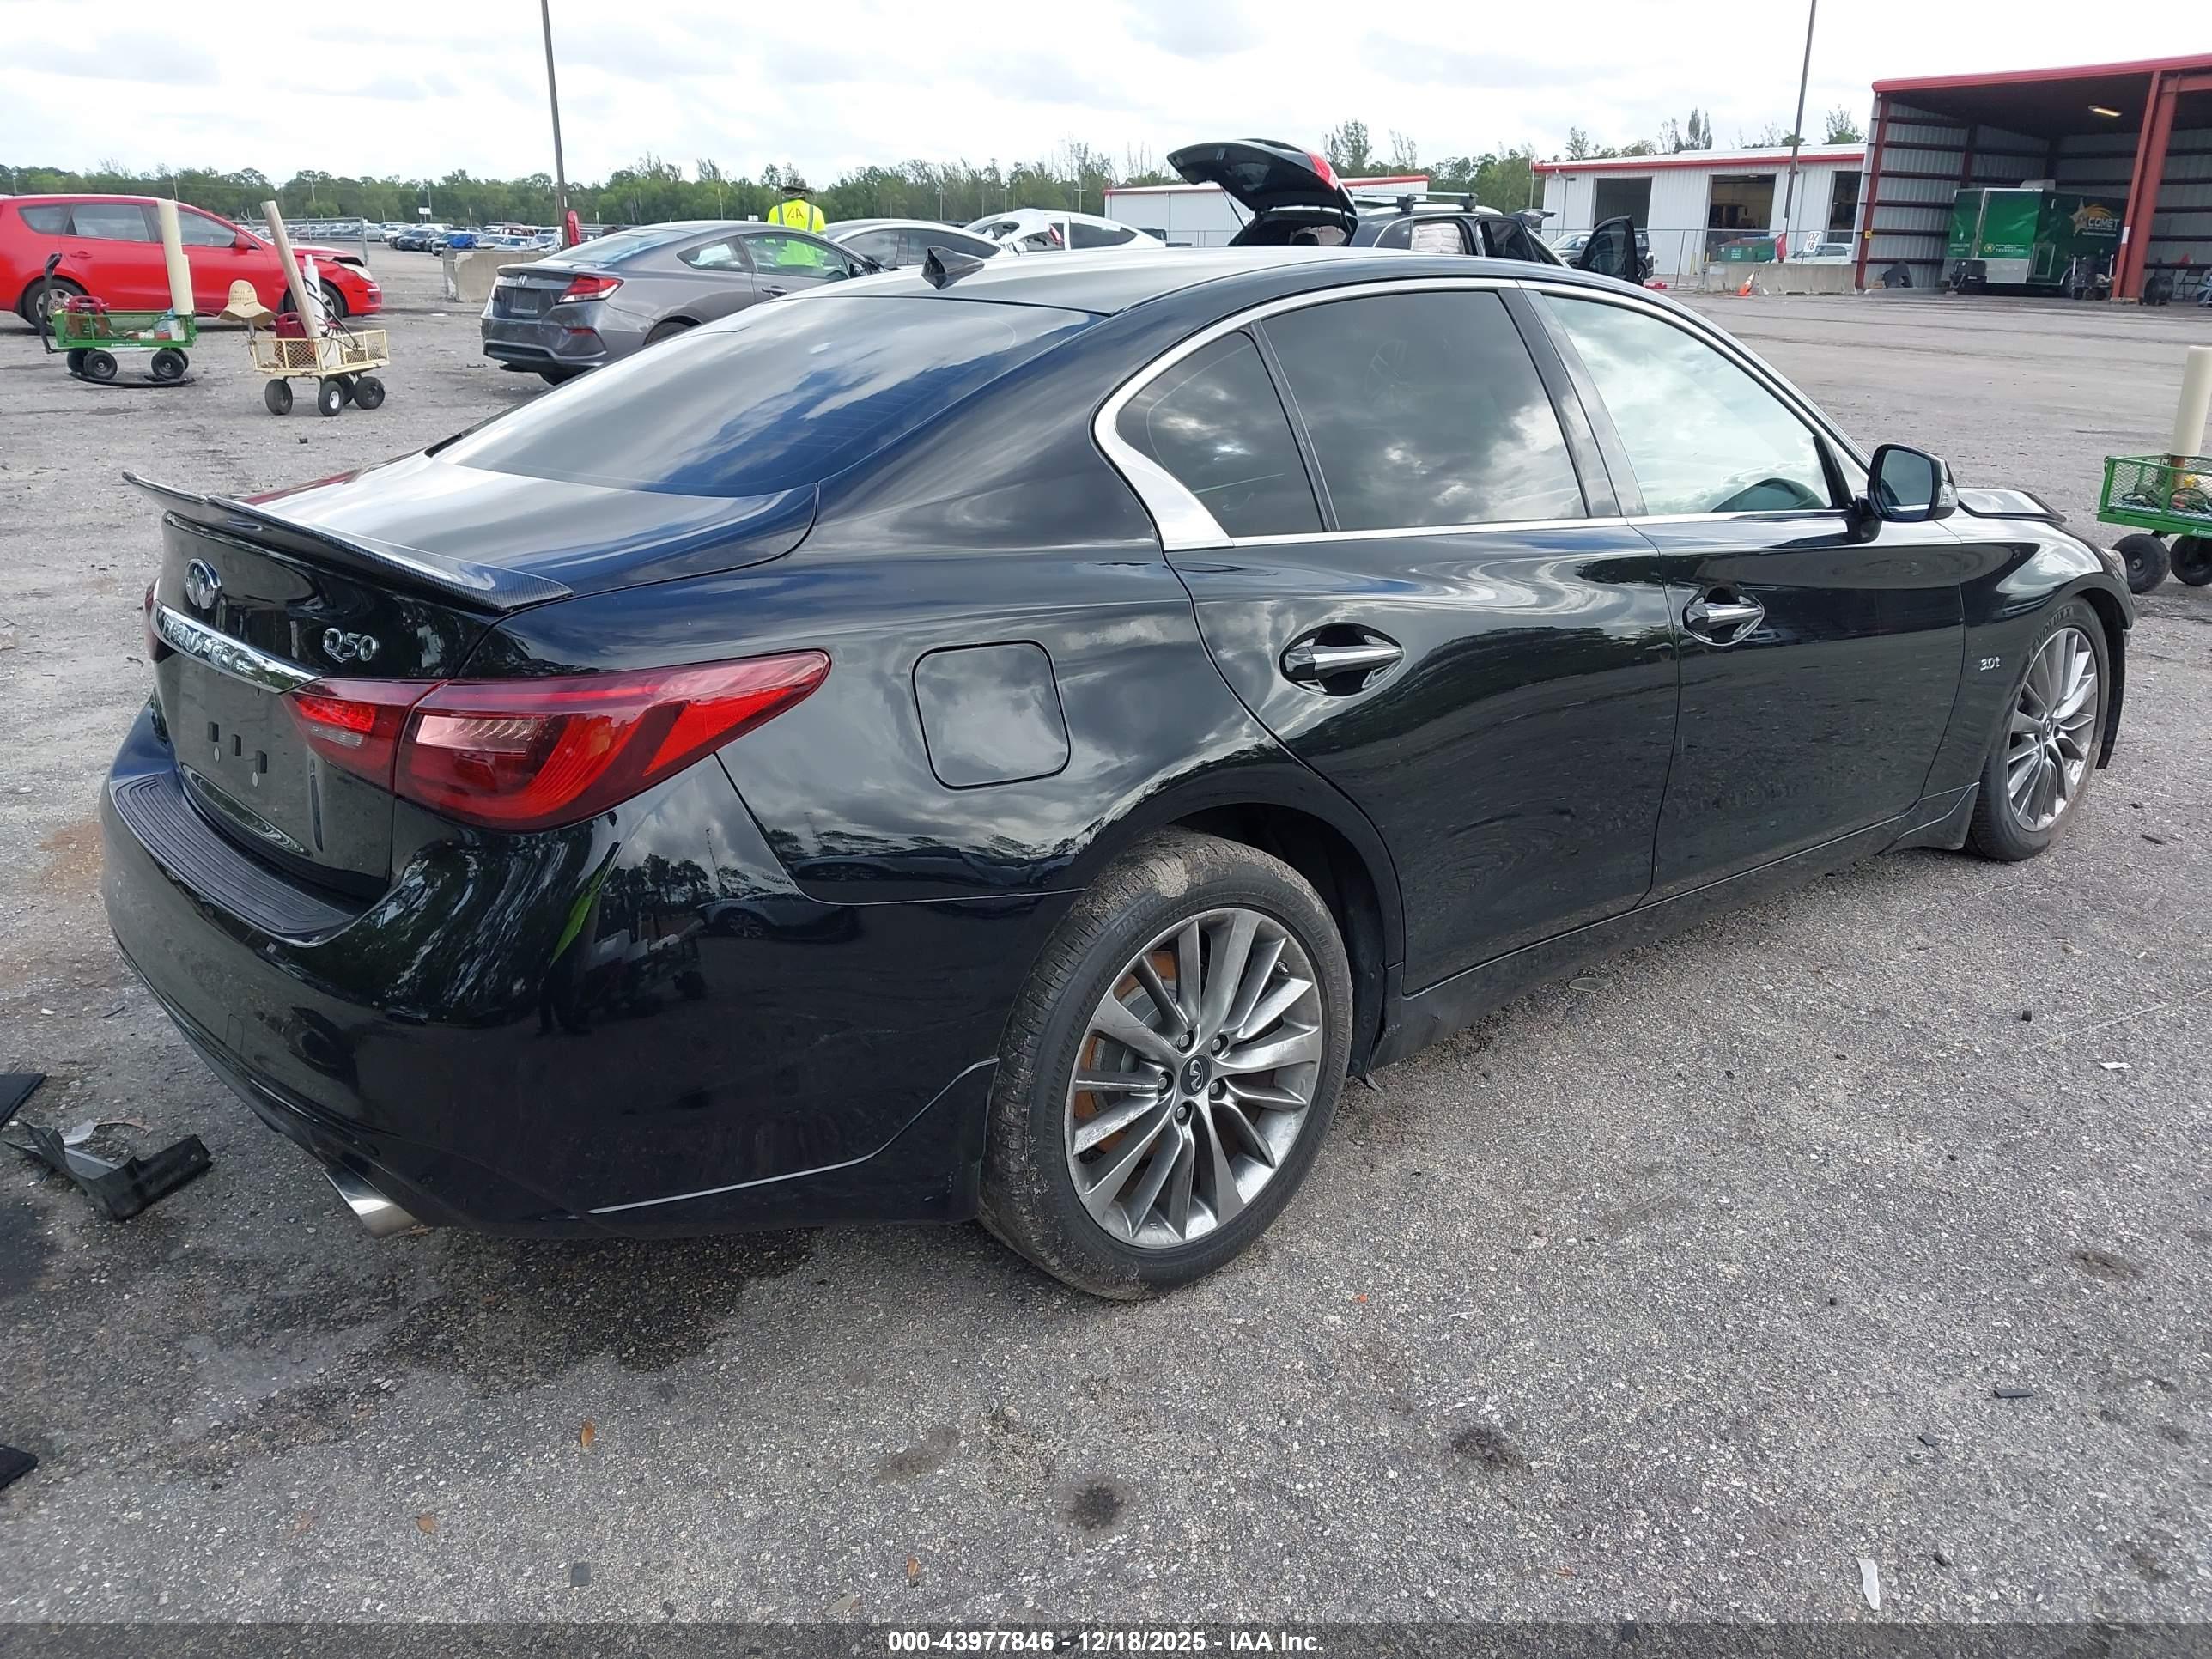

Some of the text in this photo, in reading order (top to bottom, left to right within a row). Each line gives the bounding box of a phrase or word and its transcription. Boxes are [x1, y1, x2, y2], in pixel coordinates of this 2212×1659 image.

[2087, 216, 2120, 228] COMET
[1808, 232, 1820, 241] DZ
[1807, 241, 1815, 251] 18
[323, 627, 380, 664] Q50
